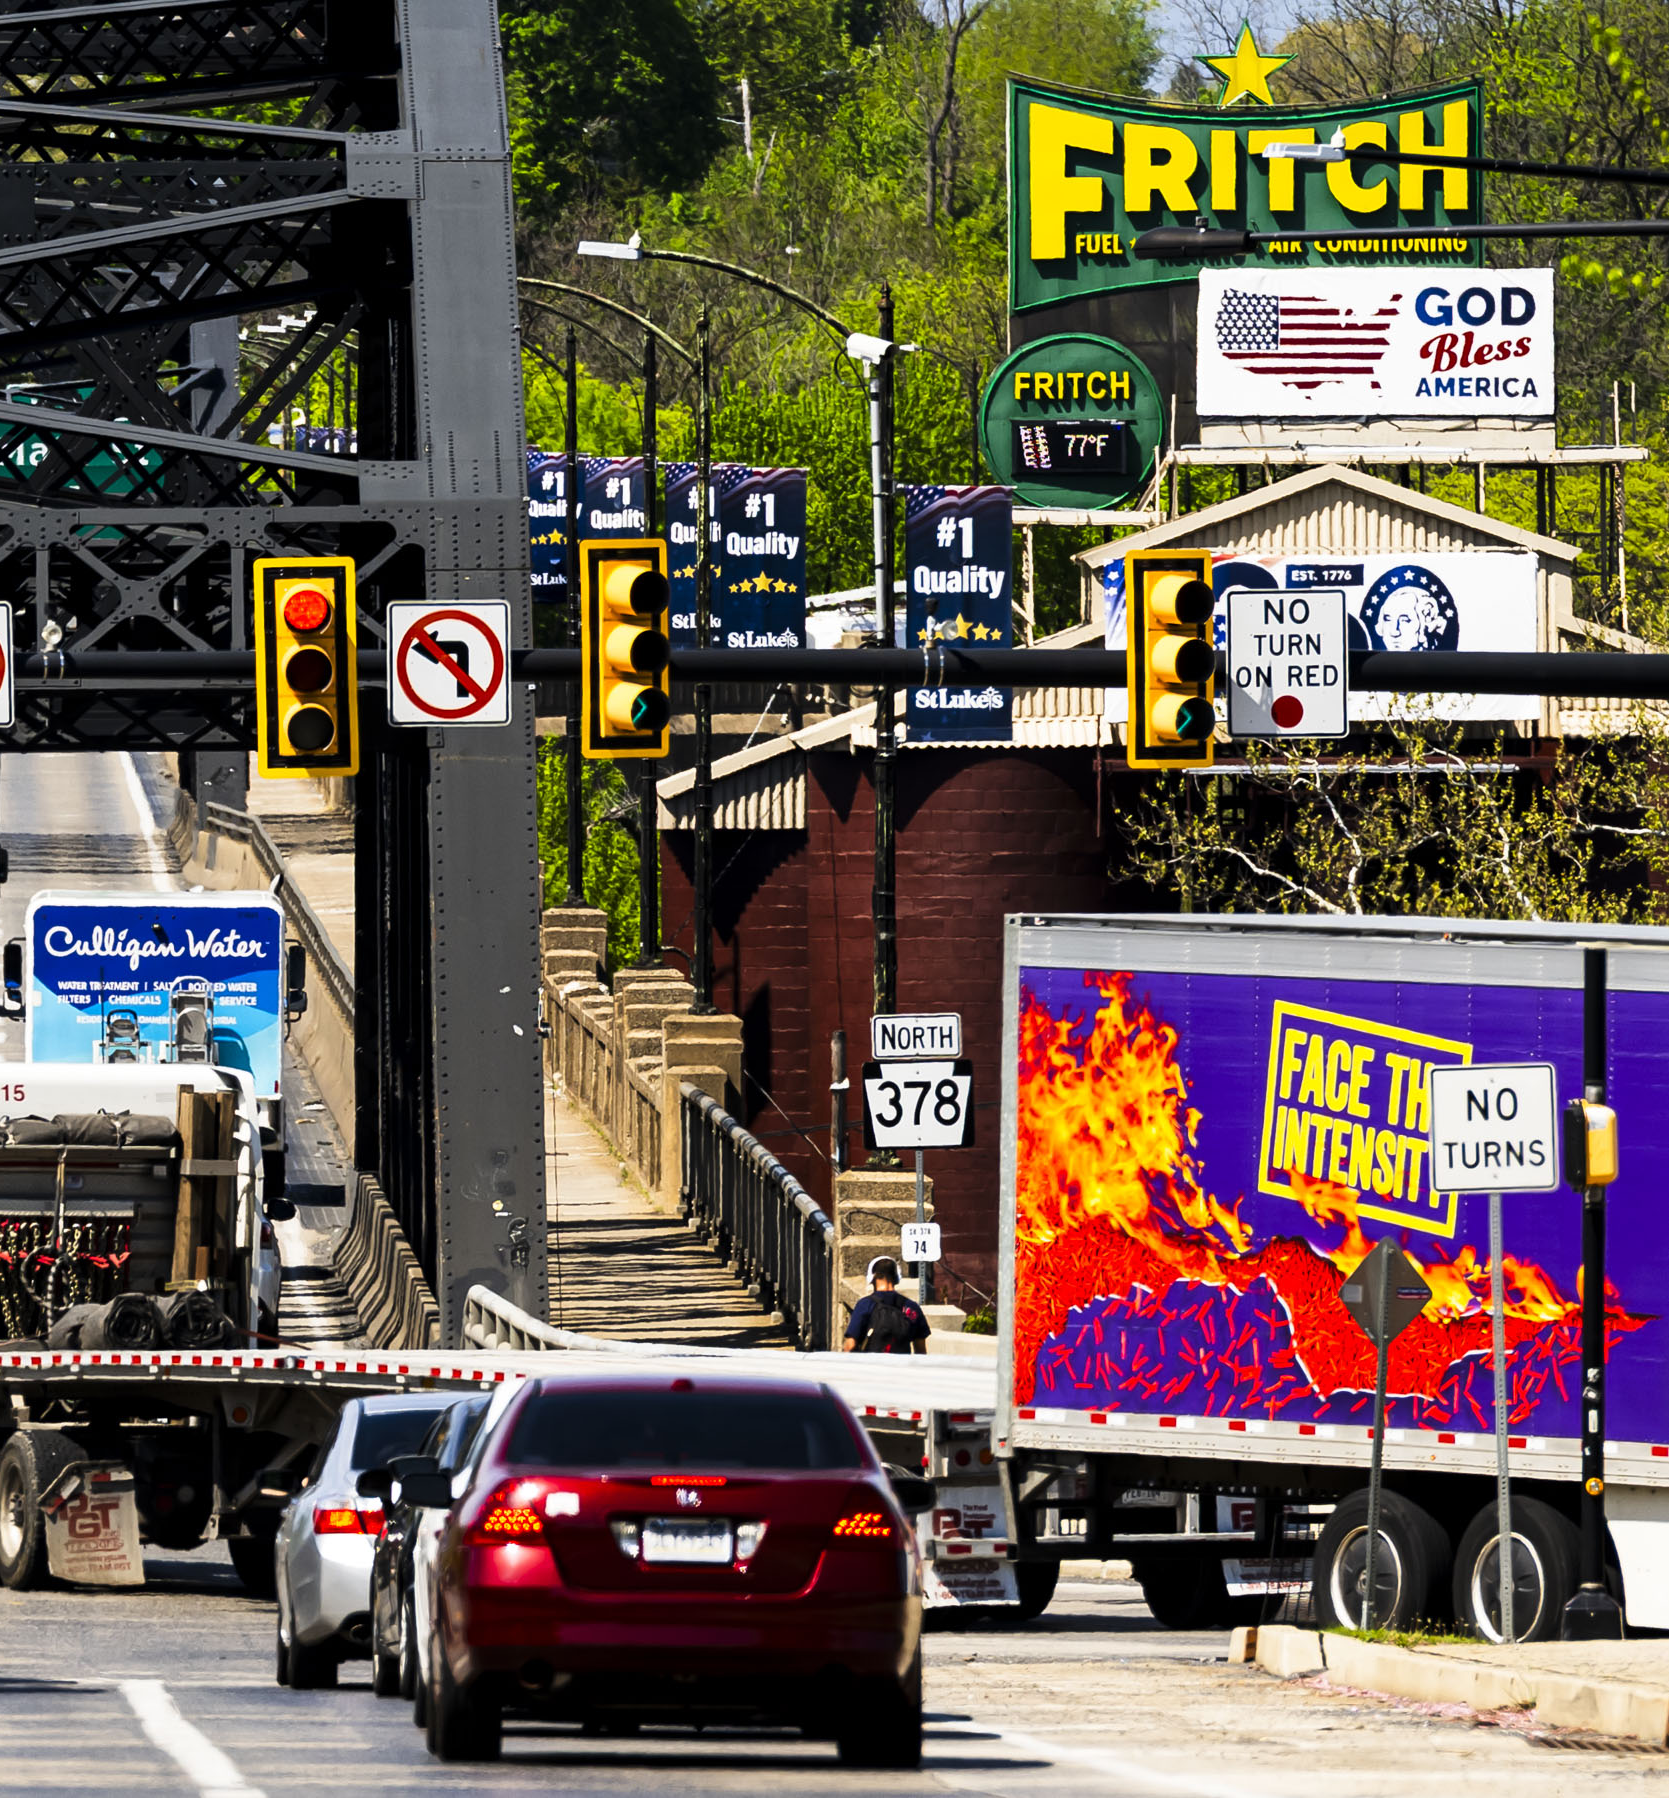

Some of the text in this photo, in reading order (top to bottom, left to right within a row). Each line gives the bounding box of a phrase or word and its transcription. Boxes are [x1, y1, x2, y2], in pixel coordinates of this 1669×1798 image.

[1030, 100, 1469, 260] FRITCH
[1076, 233, 1123, 255] FUEL
[1415, 286, 1536, 326] GOD
[1419, 331, 1532, 374] Bless
[1014, 371, 1130, 400] FRITCH
[1415, 377, 1539, 398] AMERICA
[541, 471, 565, 497] #1
[605, 477, 631, 505] #1
[528, 499, 582, 519] Qualit
[744, 493, 775, 527] #1
[726, 531, 799, 560] Quality
[937, 517, 973, 558] #1
[914, 565, 1005, 599] Quality
[1291, 569, 1352, 581] EST. 1776
[1264, 598, 1310, 625] NO
[1253, 633, 1321, 656] TURN
[1236, 664, 1339, 688] ON RED
[45, 925, 267, 971] Culligan Water
[57, 981, 87, 990] WATER
[89, 981, 139, 991] TREATMENT
[188, 982, 226, 992] BOTED
[228, 982, 257, 992] WATER
[57, 995, 91, 1004] FILTERS
[108, 995, 161, 1005] CHEMICALS
[219, 996, 257, 1006] SERVICE
[881, 1023, 953, 1051] NORTH
[1279, 1028, 1432, 1133] FACE TH
[875, 1079, 961, 1127] 378
[1467, 1088, 1518, 1121] NO
[1273, 1105, 1441, 1209] INTENSIT
[1443, 1139, 1546, 1168] TURNS
[914, 1240, 927, 1254] 74
